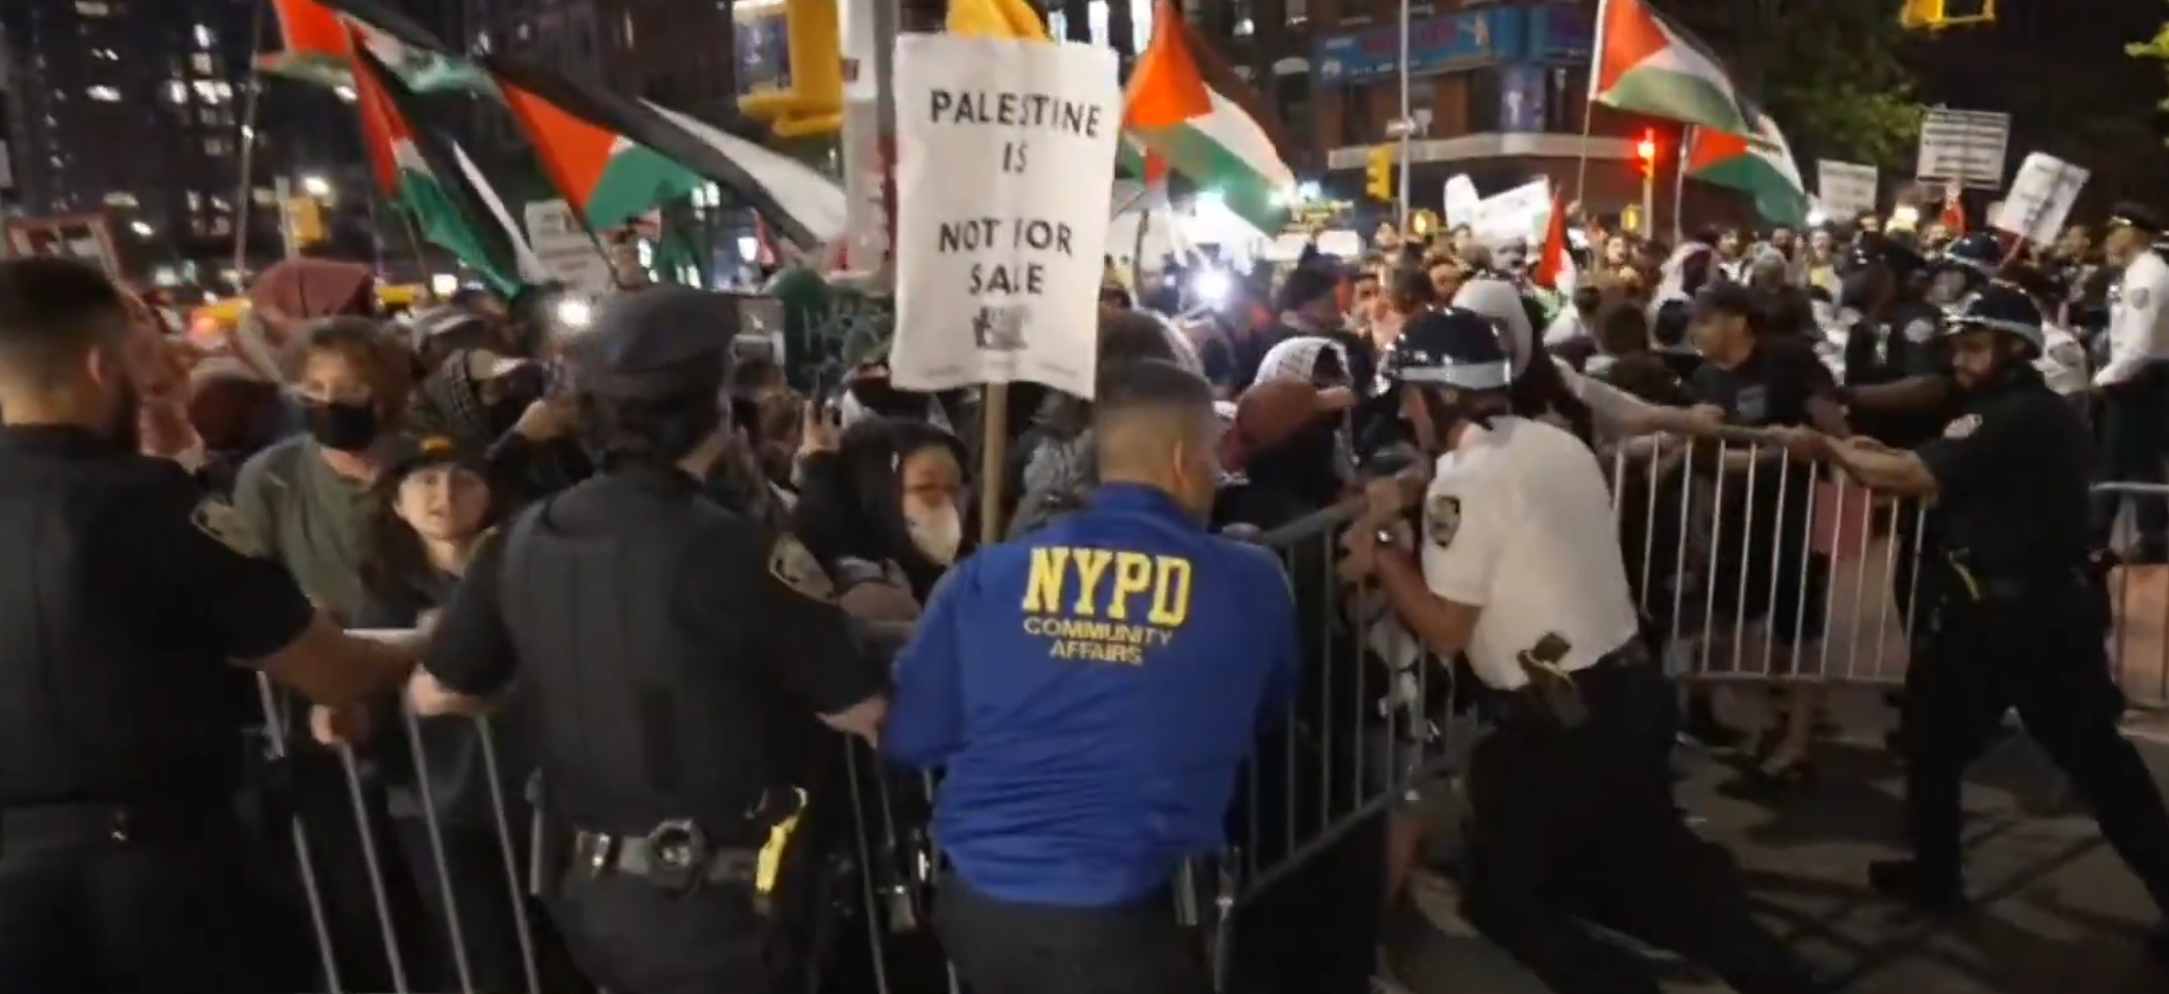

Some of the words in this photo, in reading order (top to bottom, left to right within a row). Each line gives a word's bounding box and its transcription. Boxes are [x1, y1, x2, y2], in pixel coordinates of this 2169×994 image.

[931, 89, 1101, 138] PALESTINE
[1002, 141, 1028, 173] IS
[939, 217, 1000, 252] NOT
[968, 262, 1044, 295] SALE
[1022, 547, 1191, 627] NYPD
[1023, 616, 1173, 646] COMMUNITY
[1049, 639, 1143, 667] AFFAIRS
